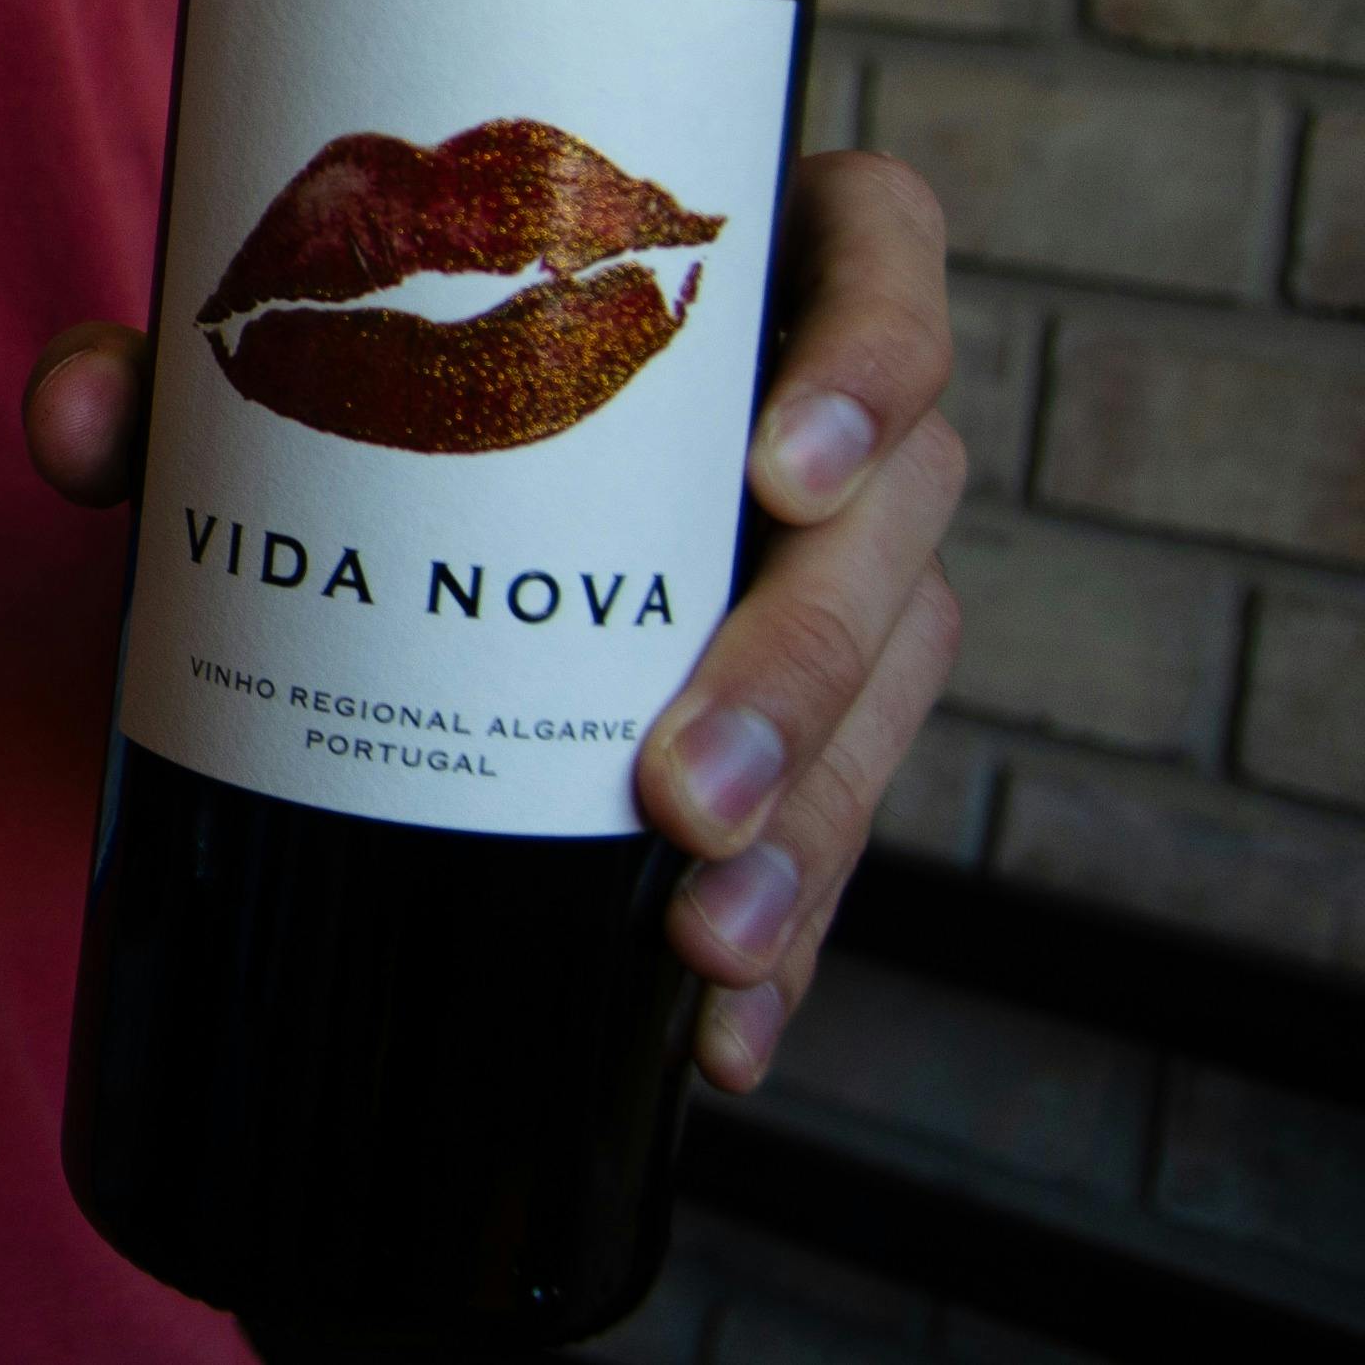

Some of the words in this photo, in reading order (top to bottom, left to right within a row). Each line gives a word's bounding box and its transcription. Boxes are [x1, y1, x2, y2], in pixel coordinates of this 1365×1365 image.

[183, 506, 375, 605] VIDA
[426, 560, 675, 627] NOVA
[189, 654, 277, 701] VINHO
[289, 685, 471, 736] REGIONAL
[487, 715, 640, 742] ALGARVE
[304, 729, 498, 778] PORTUGAL
